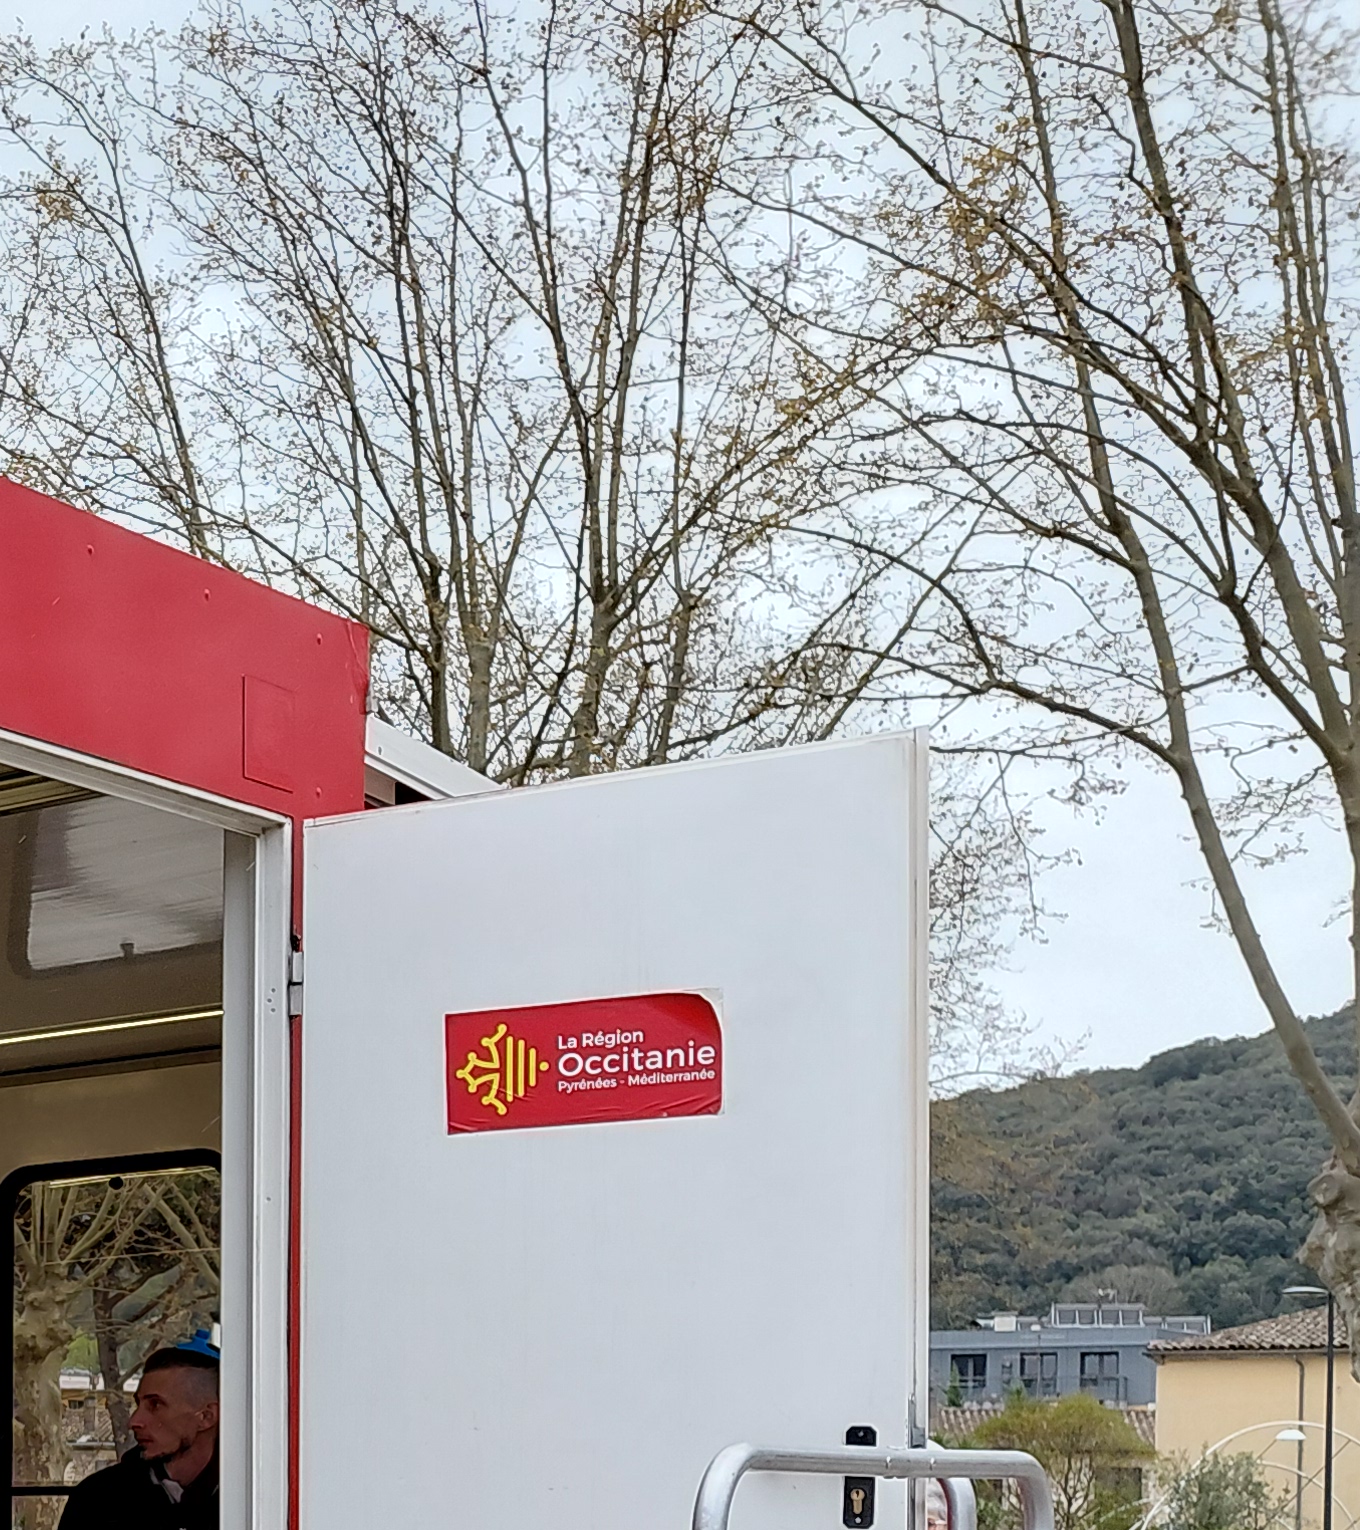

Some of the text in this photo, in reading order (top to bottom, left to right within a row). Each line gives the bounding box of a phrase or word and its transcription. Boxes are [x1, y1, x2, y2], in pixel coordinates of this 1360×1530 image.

[558, 1029, 644, 1050] La Région
[558, 1040, 716, 1077] Occitanie
[558, 1077, 617, 1094] Pyrénées
[628, 1069, 716, 1086] Méditerranée
